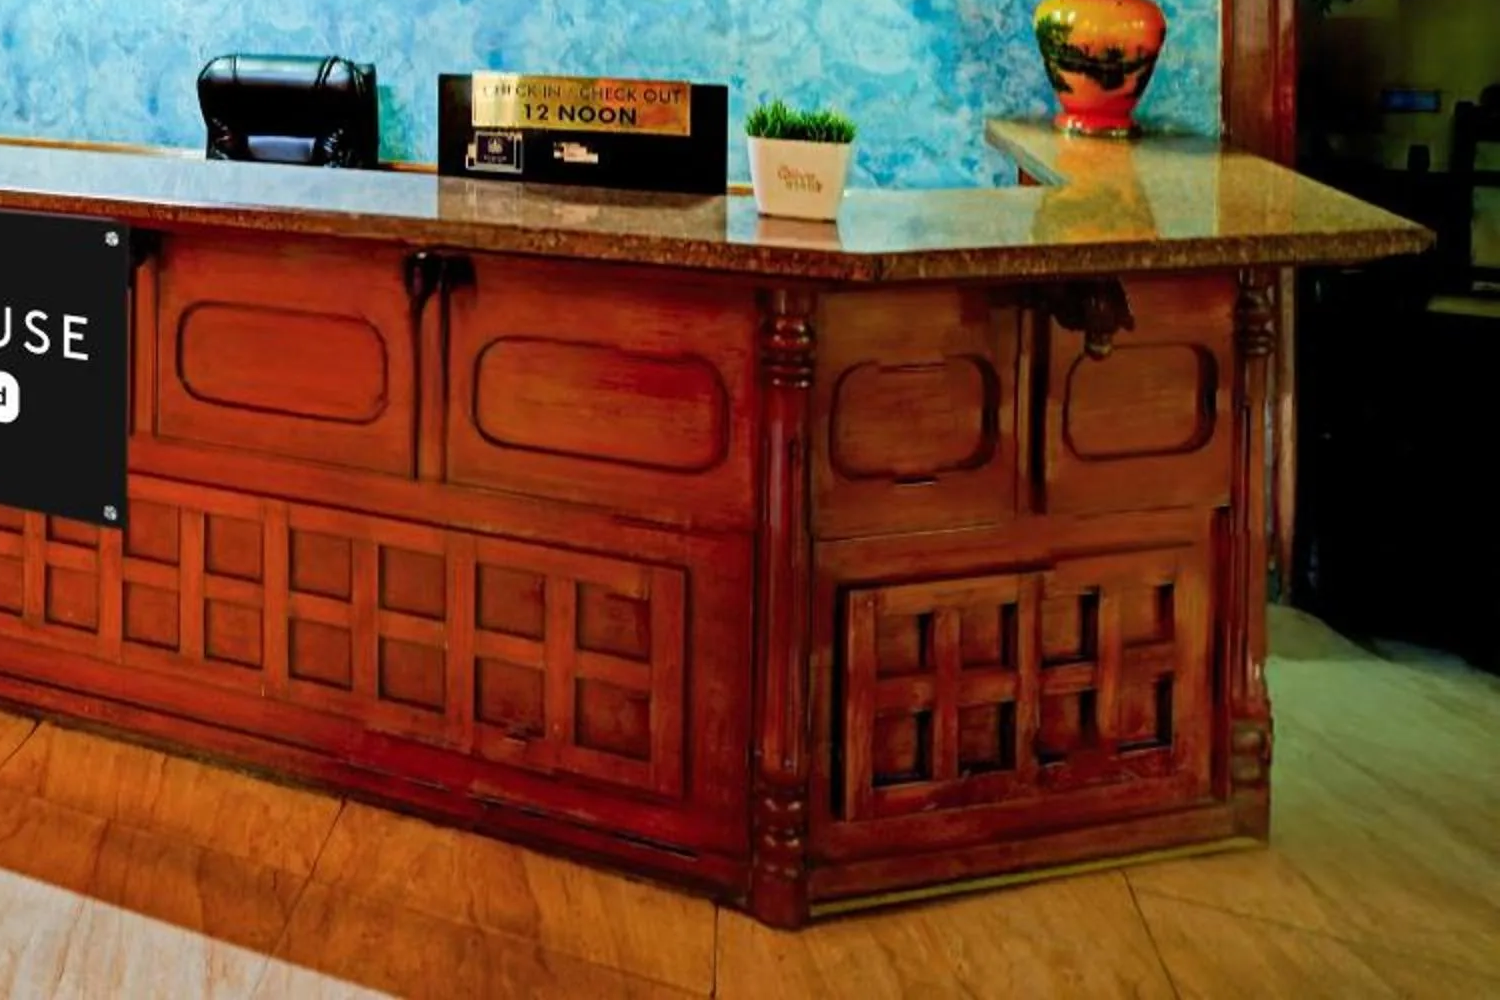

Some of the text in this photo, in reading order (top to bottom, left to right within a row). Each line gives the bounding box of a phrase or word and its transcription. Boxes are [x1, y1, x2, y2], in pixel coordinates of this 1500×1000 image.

[543, 84, 561, 97] IN
[580, 86, 637, 102] CHECK
[643, 88, 681, 104] OUT
[524, 103, 637, 125] 12 NOON
